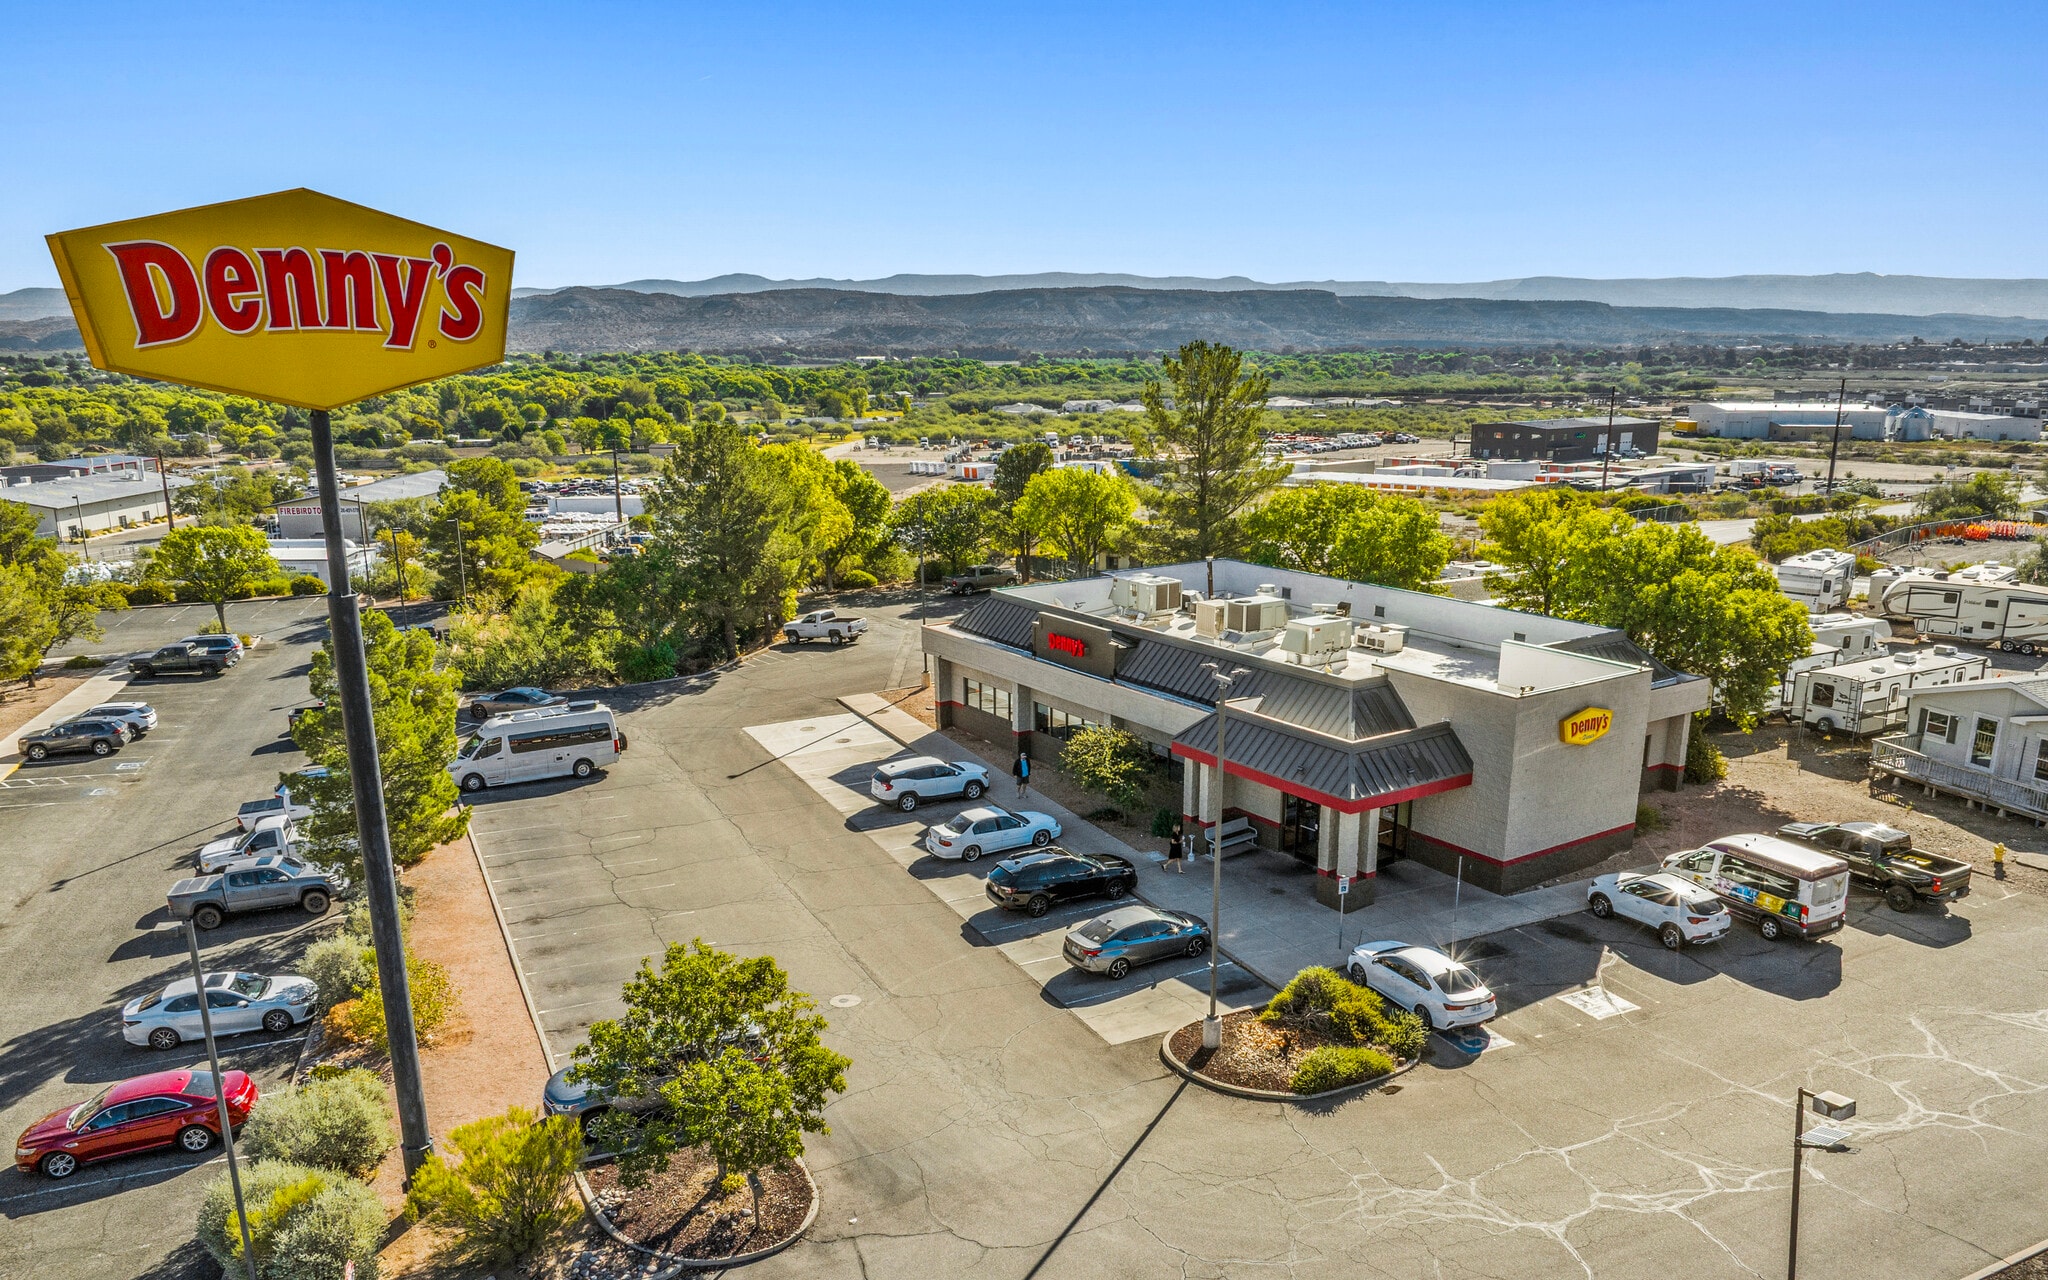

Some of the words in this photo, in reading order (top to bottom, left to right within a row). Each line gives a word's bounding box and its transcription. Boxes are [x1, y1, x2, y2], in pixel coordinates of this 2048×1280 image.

[102, 239, 486, 350] Denny's
[1048, 632, 1085, 657] Denny's
[1571, 713, 1609, 738] Denny's
